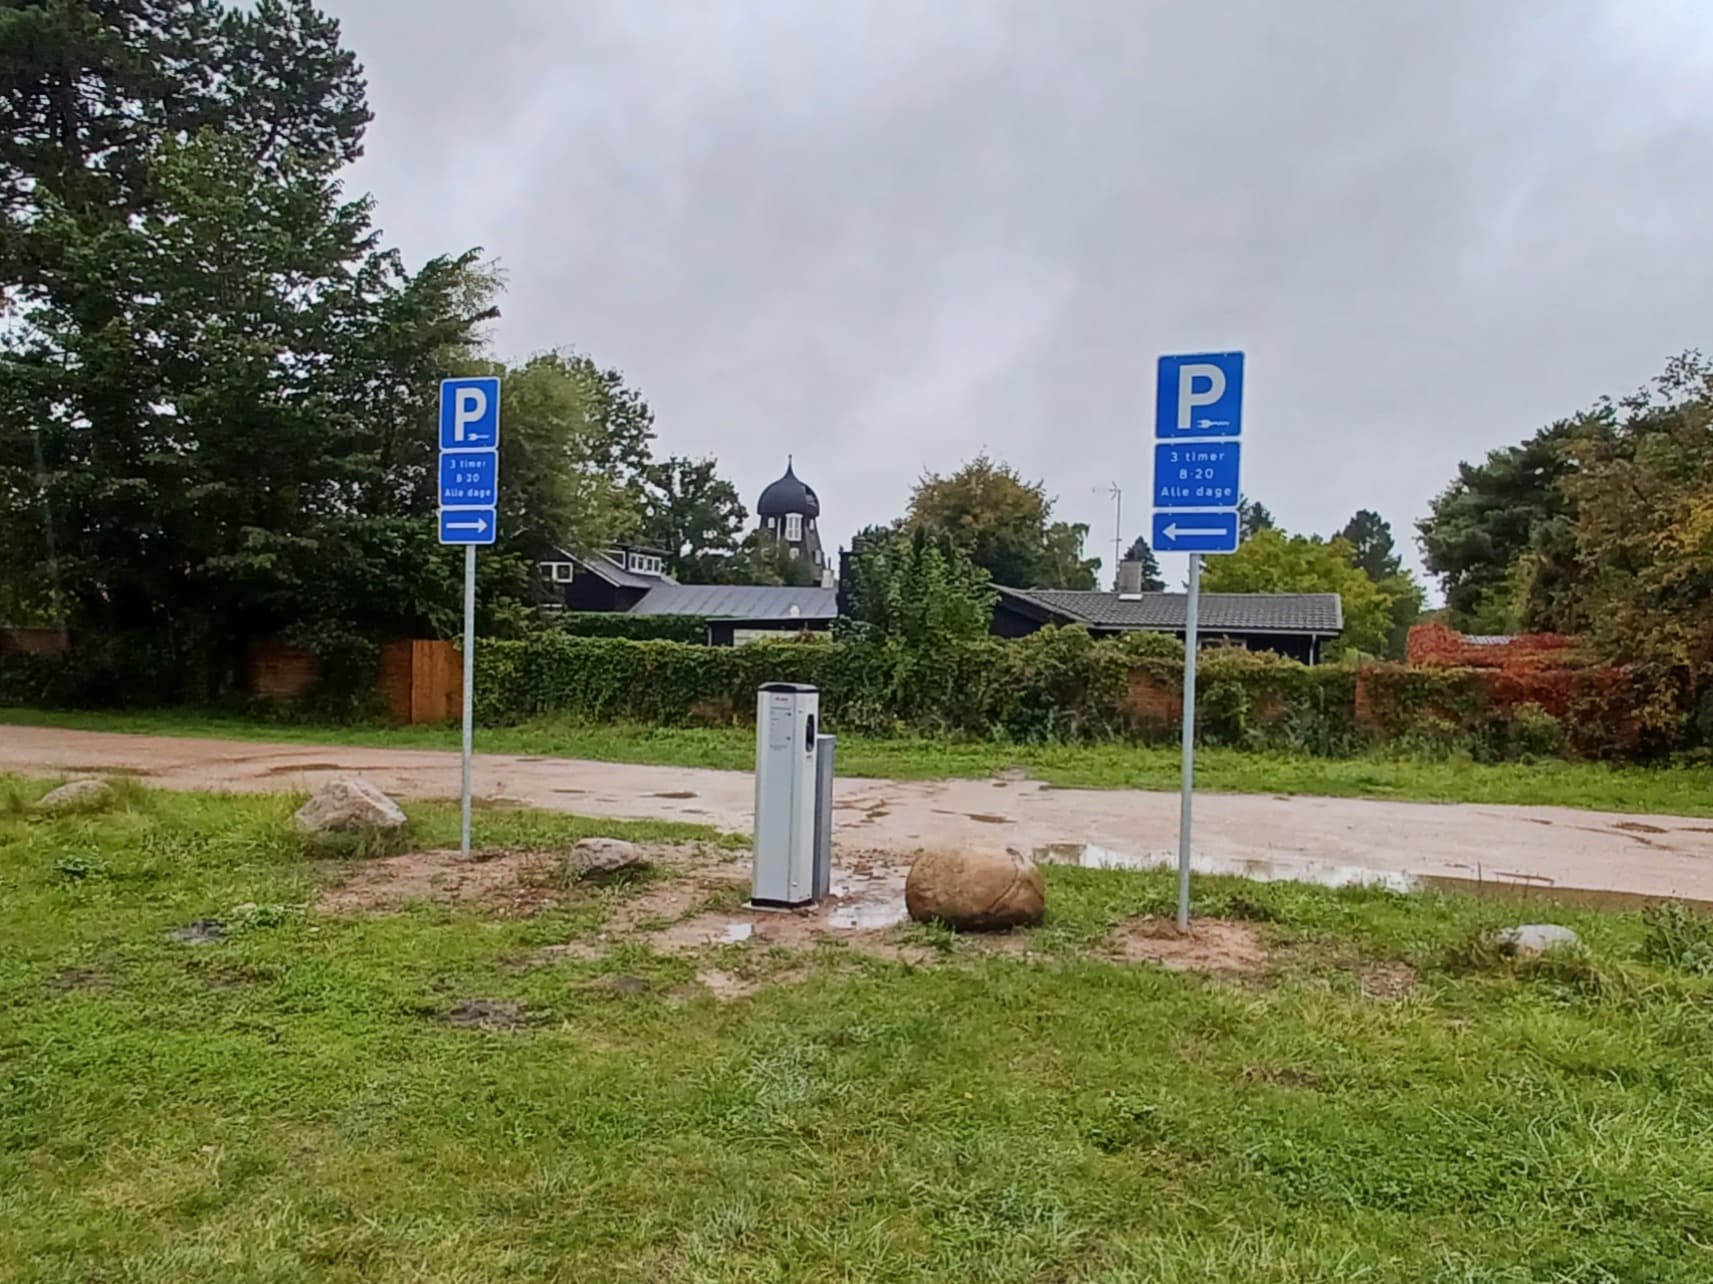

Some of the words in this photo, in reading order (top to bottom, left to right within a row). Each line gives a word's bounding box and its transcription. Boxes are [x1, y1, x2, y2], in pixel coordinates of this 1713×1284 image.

[1177, 364, 1226, 429] P
[454, 387, 487, 441] P
[1170, 451, 1178, 462] 3
[1185, 451, 1225, 462] timer
[449, 459, 456, 469] 3
[460, 459, 487, 468] timer
[444, 488, 464, 497] Alle
[467, 488, 491, 499] dage
[1160, 486, 1190, 497] Alle
[1195, 486, 1232, 499] dage
